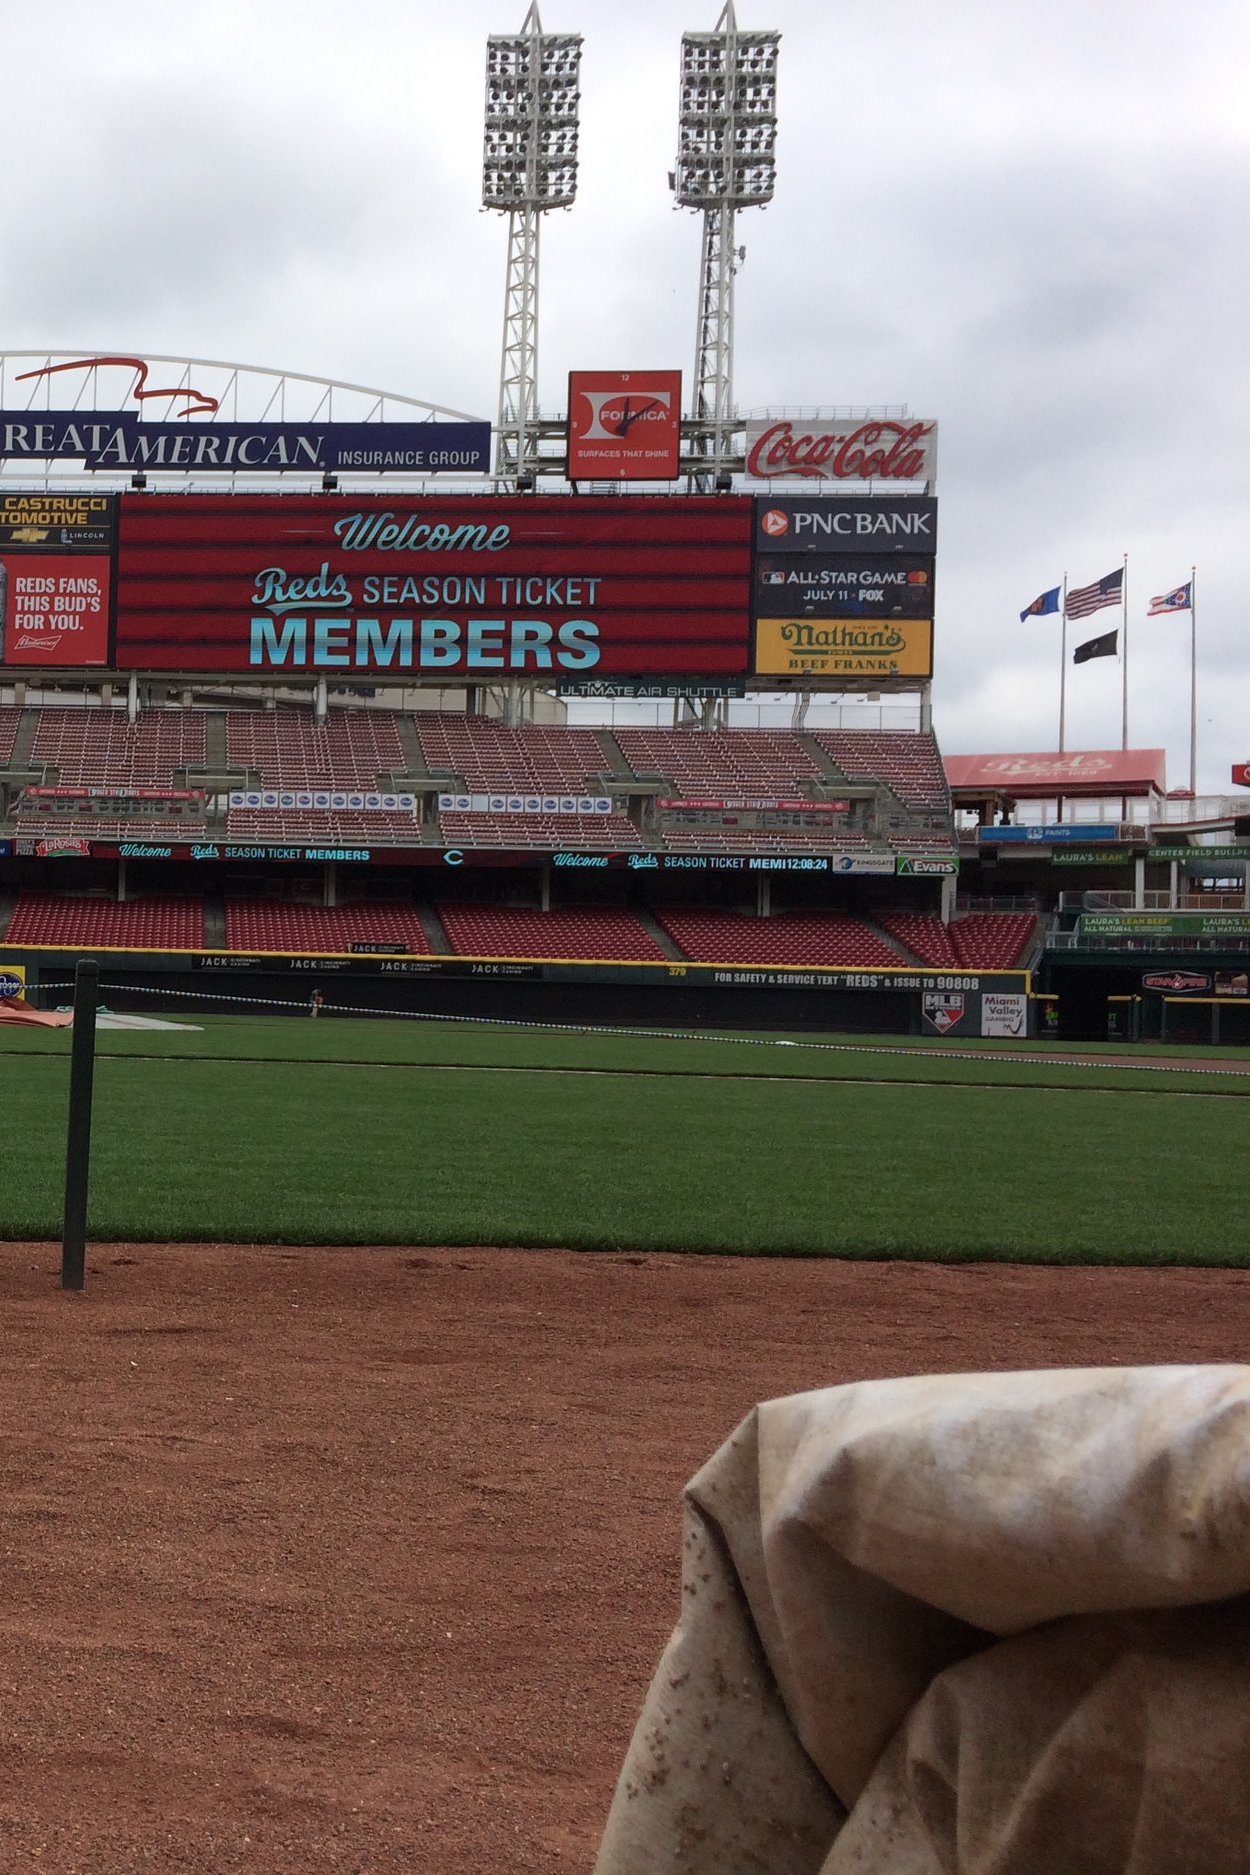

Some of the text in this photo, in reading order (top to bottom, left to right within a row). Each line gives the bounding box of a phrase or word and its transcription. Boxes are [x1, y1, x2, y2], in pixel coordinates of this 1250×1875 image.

[96, 426, 323, 464] AMERICAN
[338, 450, 424, 465] INSURANCE
[429, 450, 480, 465] GROUP
[578, 450, 670, 458] SURFACES THAT SHINE
[4, 498, 107, 511] CASTRUCCI
[792, 512, 932, 534] PNC BANK
[333, 511, 511, 551] Welcome
[859, 571, 907, 585] GAME
[15, 577, 102, 597] REDS FANS,
[251, 561, 602, 613] Reds SEASON TICKET
[802, 589, 884, 602] JULY 11 FOX
[15, 596, 101, 613] THIS BUD'S
[14, 614, 84, 630] FOR YOU.
[780, 622, 907, 650] Nathan's
[249, 617, 601, 669] MEMBERS
[788, 658, 899, 669] BEEF FRANKS
[560, 685, 738, 698] ULTIMATE AIR SHUTTLE
[118, 843, 371, 861] Welcome Reds SEASON TICKET MEMBERS
[1053, 852, 1123, 863] LAURA'S LEAN
[1148, 849, 1185, 858] CENTER
[1186, 849, 1212, 857] FIELD
[552, 852, 610, 868] Welcome
[627, 853, 659, 870] Reds
[664, 857, 707, 869] SEASON
[709, 857, 746, 869] TICKET
[913, 860, 954, 873] Evans
[1085, 917, 1120, 926] LAURA'S
[1147, 918, 1169, 926] BEEF
[1203, 918, 1240, 926] LAURA'S
[353, 944, 377, 953] JACK
[200, 957, 228, 966] JACK
[289, 959, 317, 969] JACK
[380, 962, 408, 971] JACK
[471, 964, 499, 974] JACK
[714, 972, 732, 982] FOR
[734, 973, 767, 984] SAFETY
[768, 974, 776, 984] &
[776, 974, 816, 985] SERVICE
[816, 975, 838, 986] TEXT
[884, 977, 892, 988] &
[893, 977, 921, 988] ISSUE
[922, 978, 935, 988] TO
[936, 977, 980, 990] 90808
[925, 994, 962, 1007] MLB
[984, 996, 1020, 1006] Miami
[988, 1005, 1023, 1018] Valley
